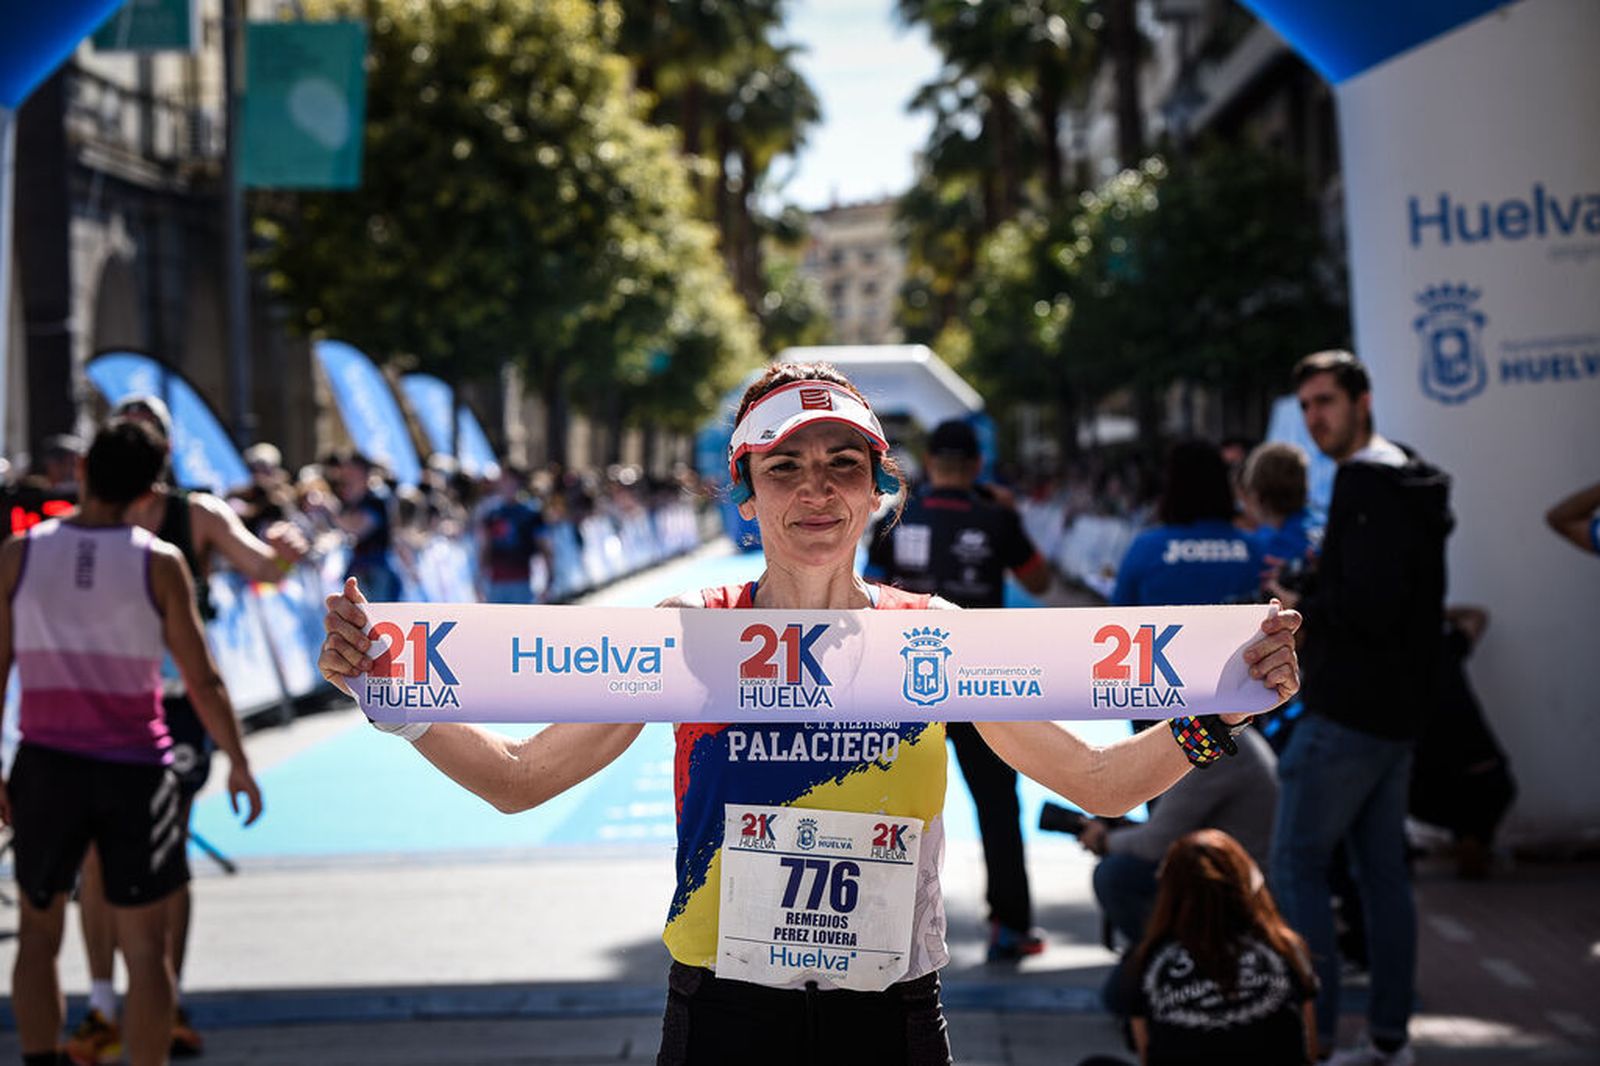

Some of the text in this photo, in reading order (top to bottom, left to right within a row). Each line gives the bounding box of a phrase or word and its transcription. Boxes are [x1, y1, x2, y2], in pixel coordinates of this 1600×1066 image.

[366, 621, 460, 685] 21K
[512, 636, 662, 674] Huelva
[740, 623, 832, 685] 21K
[1093, 624, 1184, 687] 21K
[958, 666, 1042, 677] Ayuntamiento de
[366, 685, 460, 707] HUELVA
[609, 679, 662, 694] original
[740, 686, 833, 708] HUELVA
[958, 680, 1042, 696] HUELVA
[1093, 687, 1186, 708] HUELVA
[727, 731, 900, 762] PALACIEGO
[741, 812, 778, 841] 21K
[872, 823, 909, 852] 21K
[739, 837, 776, 850] HUELVA
[818, 840, 853, 850] HUELVA
[870, 847, 907, 860] HUELVA
[780, 857, 861, 914] 776
[785, 912, 849, 929] REMEDIOS
[773, 927, 857, 946] PEREZ LOVERA
[770, 943, 849, 971] Huelva
